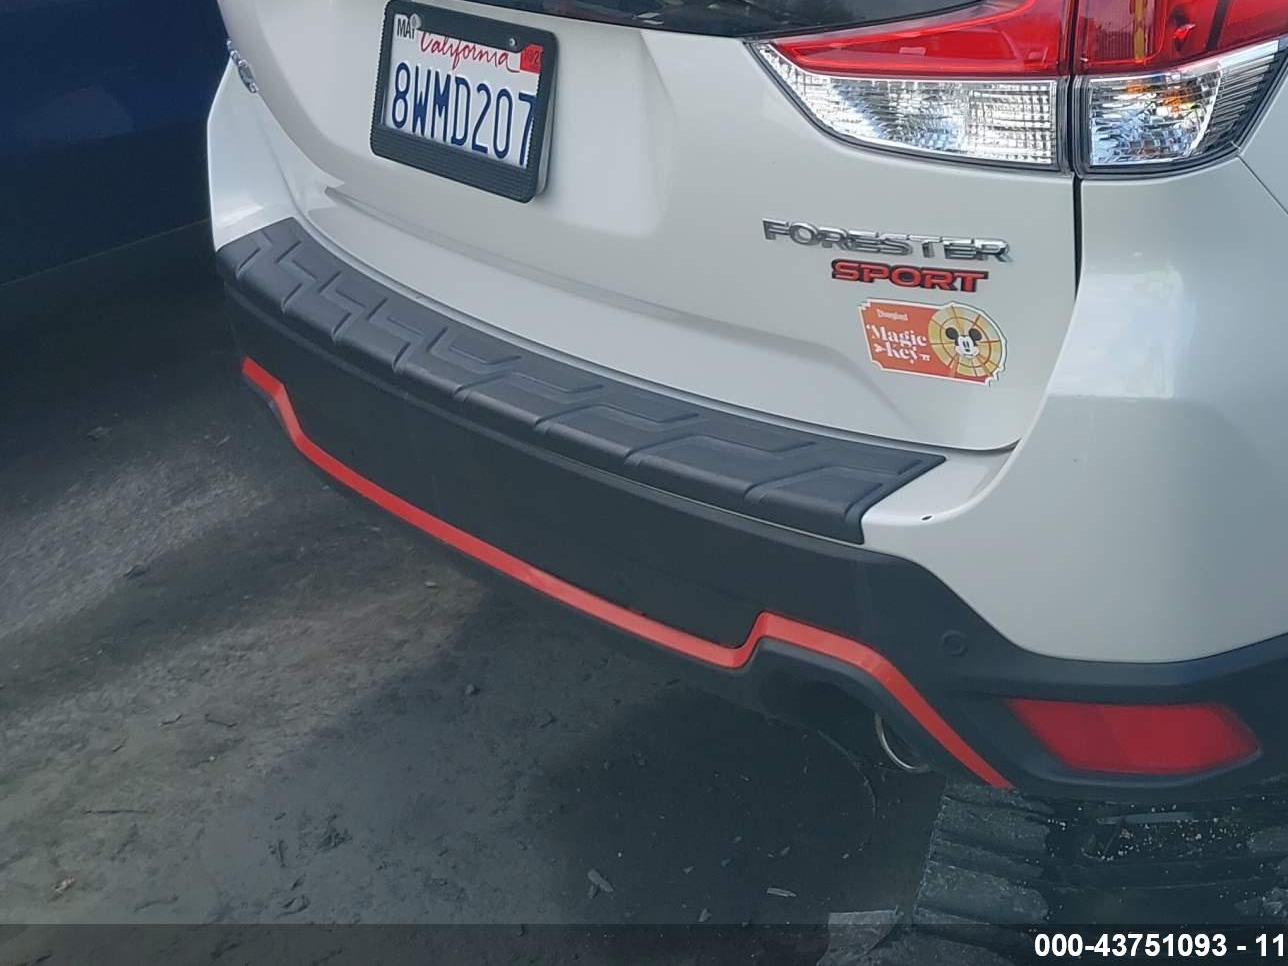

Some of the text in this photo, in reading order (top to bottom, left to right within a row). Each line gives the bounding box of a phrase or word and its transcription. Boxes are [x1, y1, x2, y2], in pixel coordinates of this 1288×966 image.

[420, 31, 520, 73] California
[391, 61, 538, 167] 8WMD207
[762, 218, 1010, 262] FORESTER
[830, 258, 989, 293] SPORT
[866, 323, 928, 348] Magic
